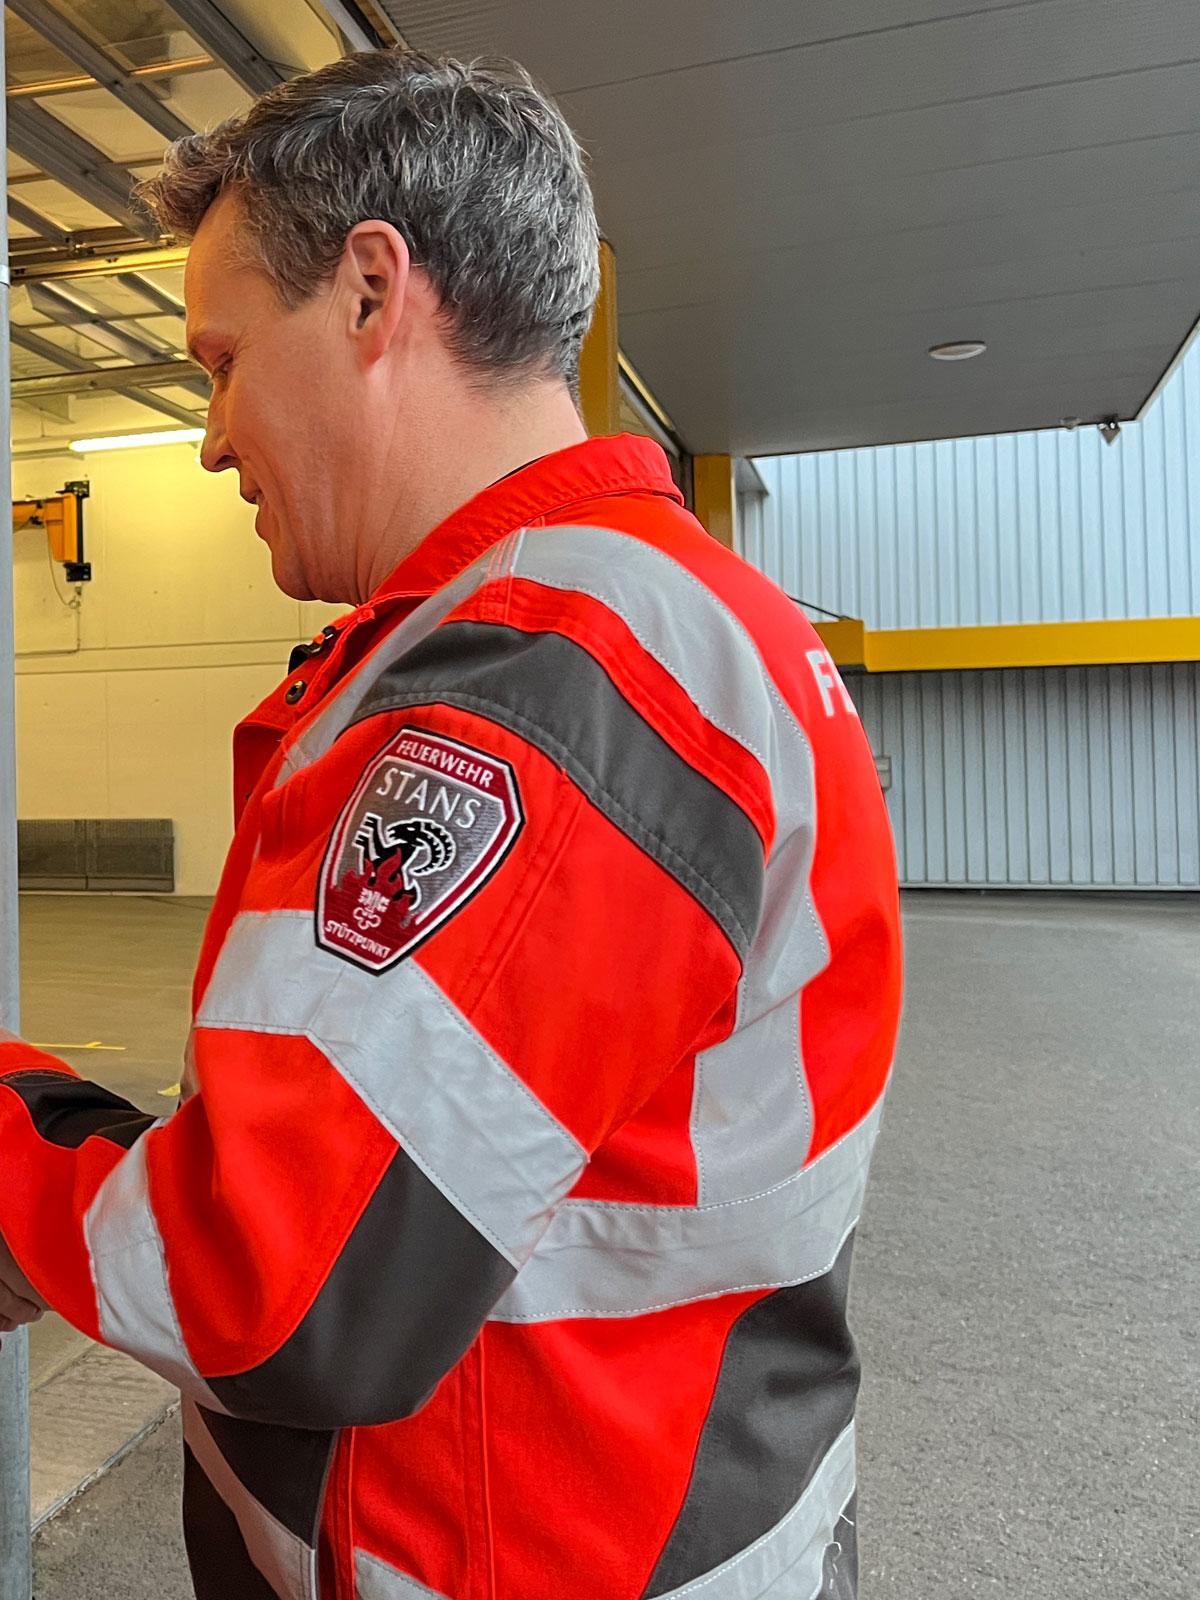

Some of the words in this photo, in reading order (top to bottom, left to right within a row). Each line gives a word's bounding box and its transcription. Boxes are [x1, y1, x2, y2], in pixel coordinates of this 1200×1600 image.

[396, 740, 495, 788] FEUERWEHR
[376, 767, 482, 829] STANS
[325, 920, 391, 958] STÜTZPUNKT
